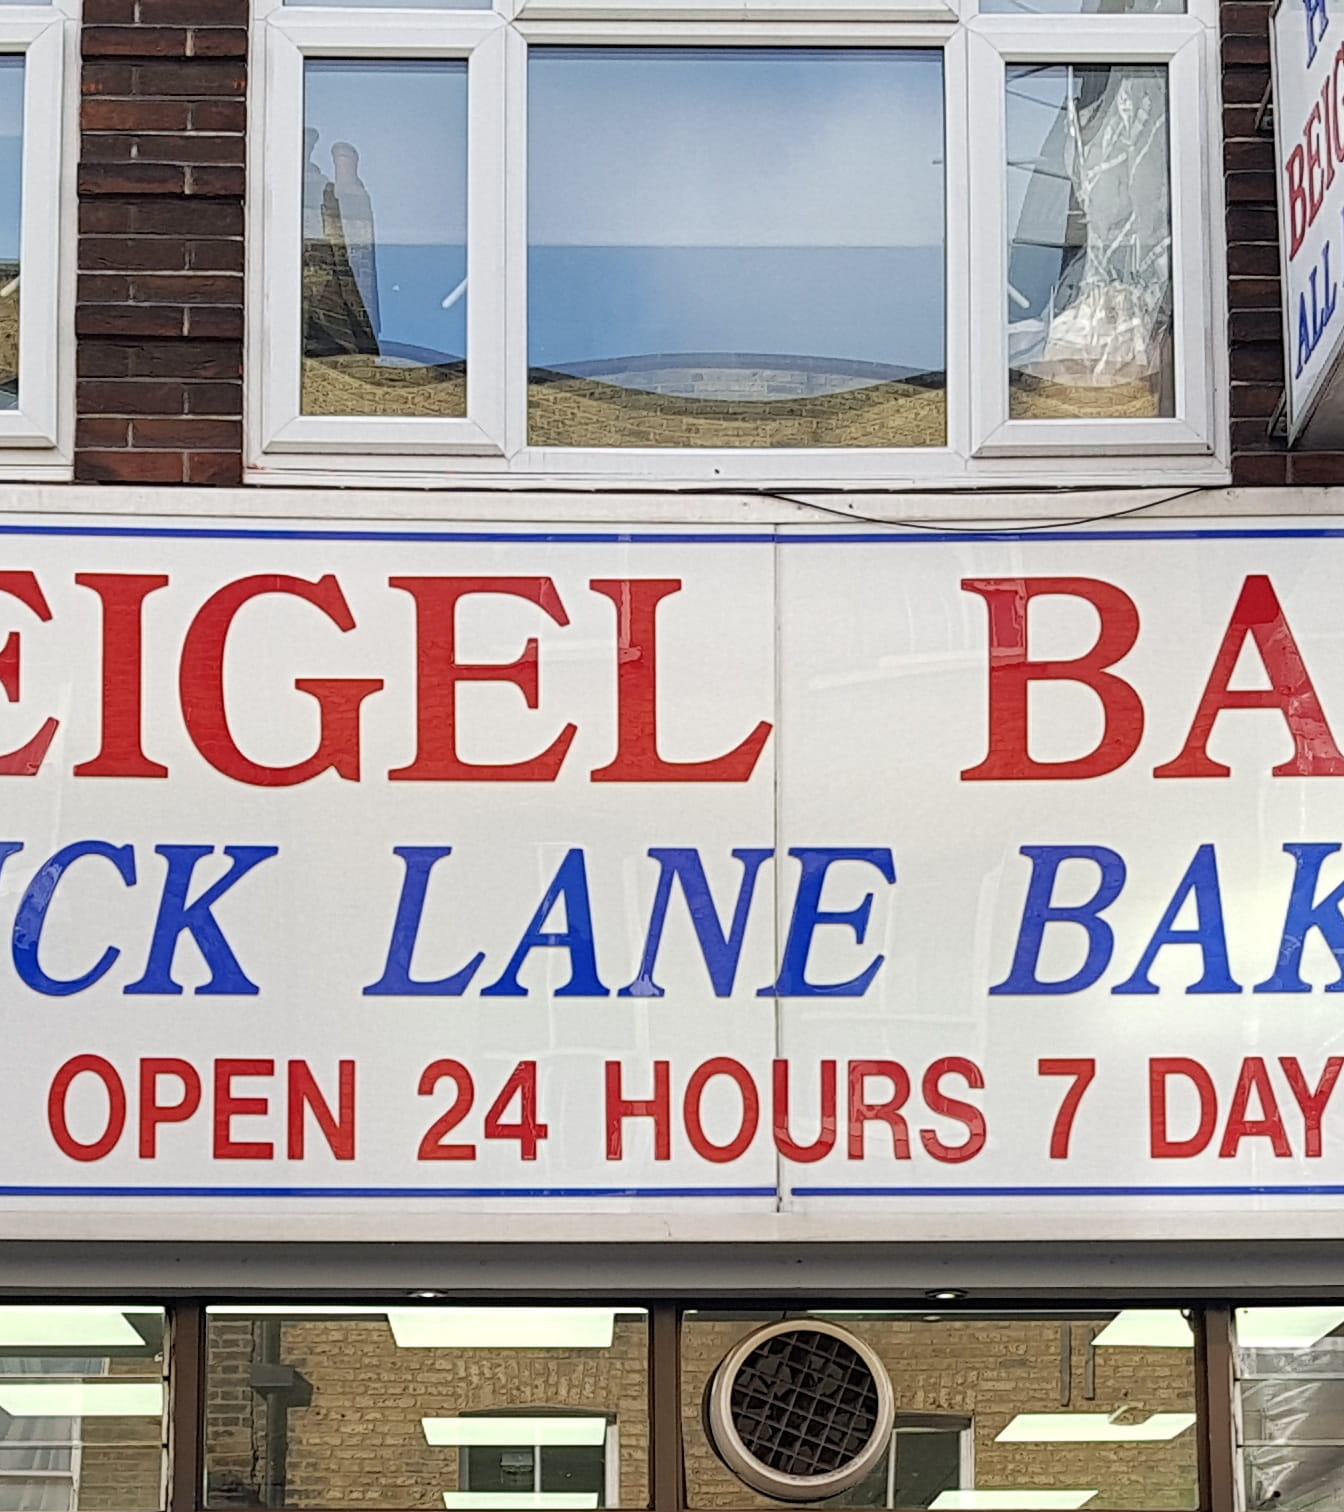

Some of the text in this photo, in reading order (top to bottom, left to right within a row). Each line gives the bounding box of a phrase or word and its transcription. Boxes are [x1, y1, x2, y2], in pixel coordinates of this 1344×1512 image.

[1295, 240, 1338, 379] ALL
[364, 846, 896, 996] LANE
[48, 1054, 356, 1162] OPEN
[418, 1059, 549, 1160] 24
[606, 1057, 987, 1163] HOURS
[1039, 1058, 1096, 1158] 7
